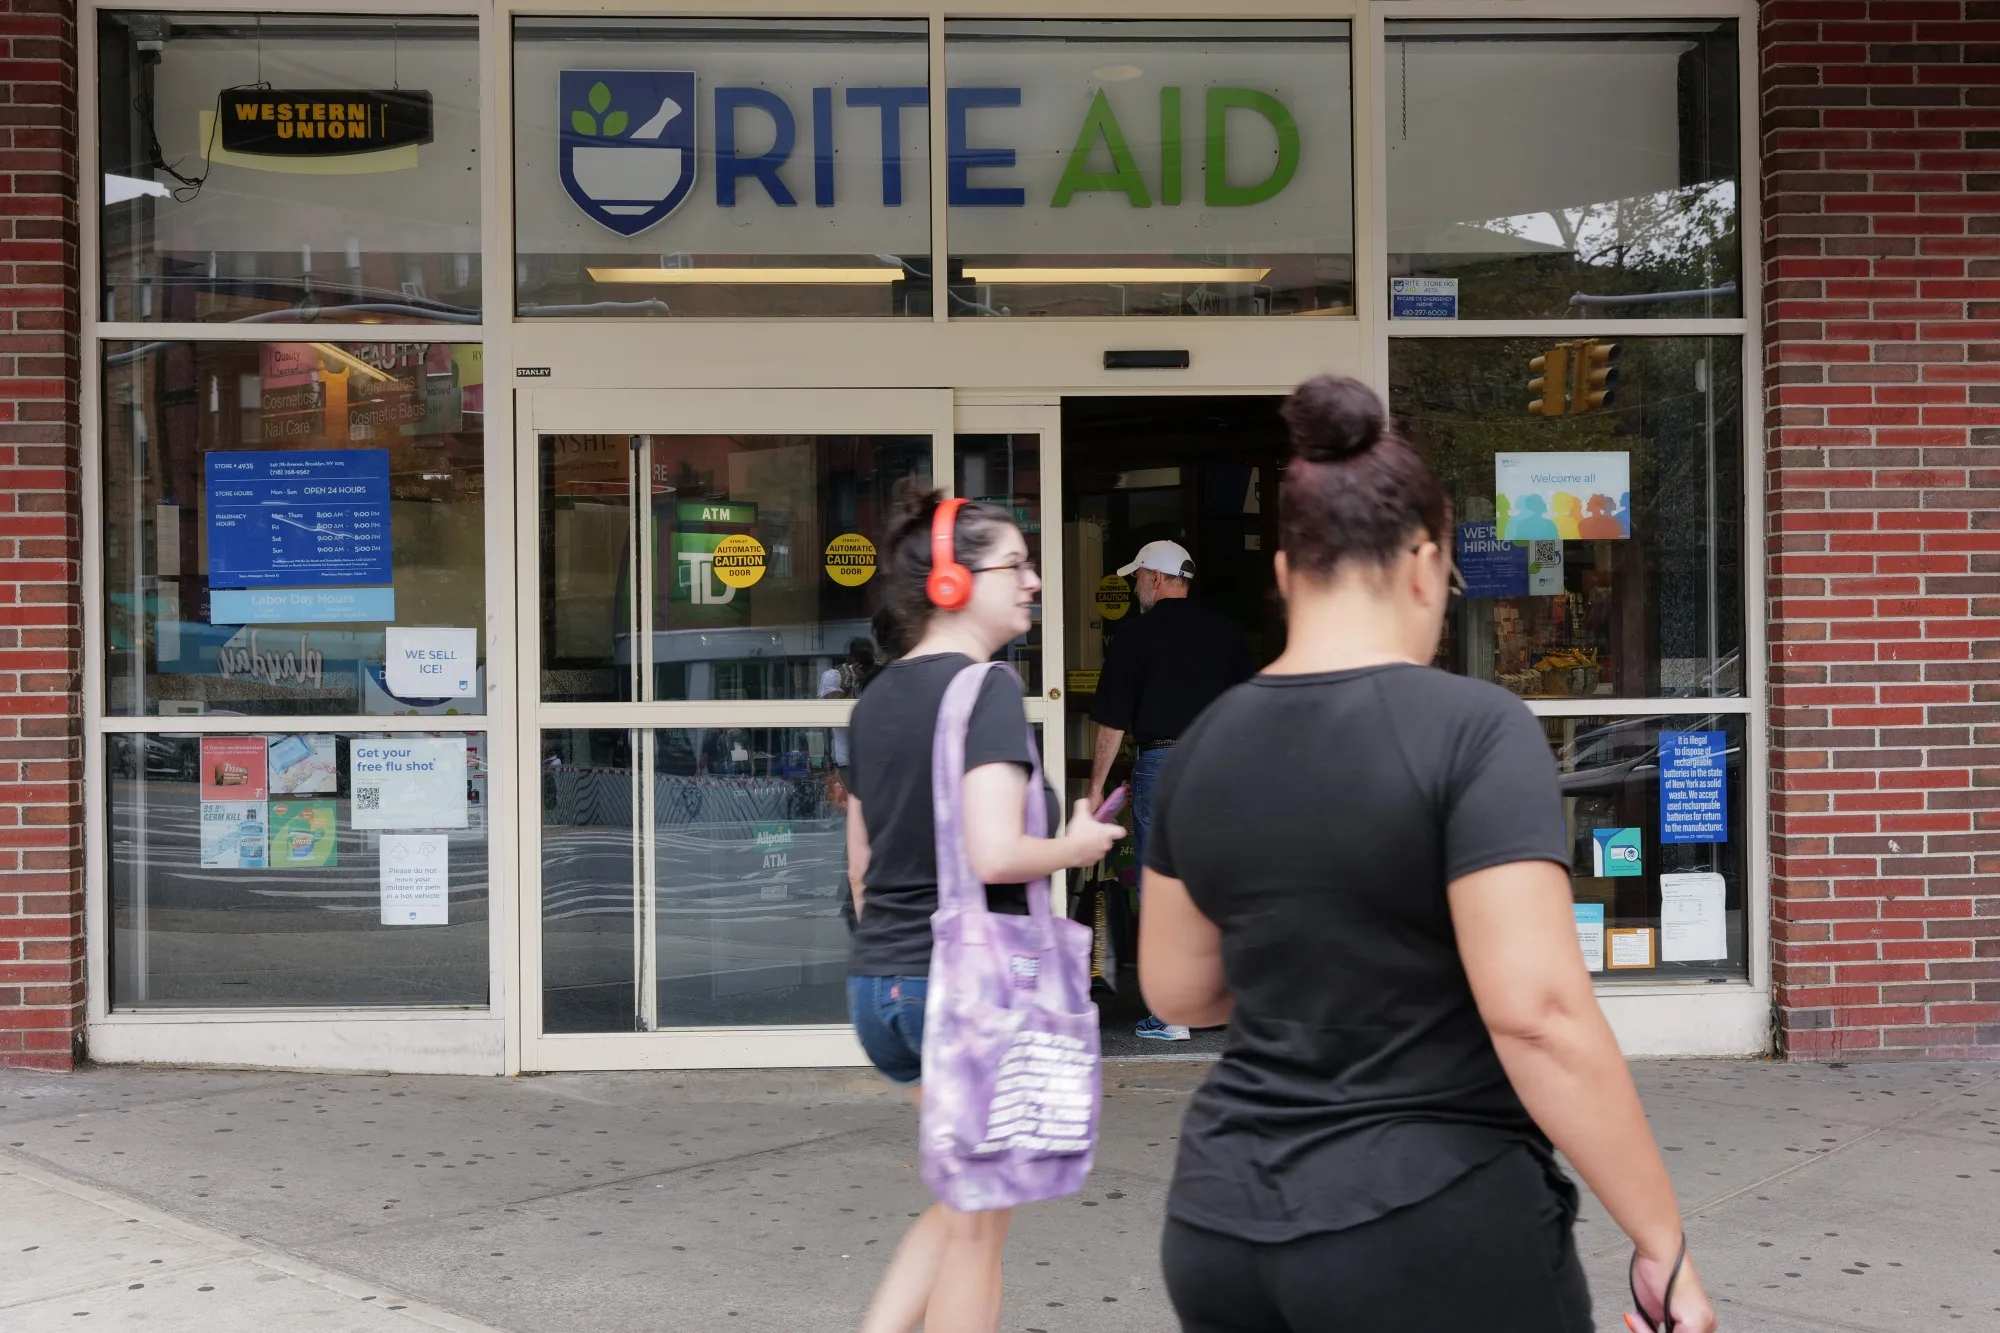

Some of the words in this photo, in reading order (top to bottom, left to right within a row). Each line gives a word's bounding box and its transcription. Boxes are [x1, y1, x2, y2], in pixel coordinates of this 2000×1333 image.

[235, 104, 365, 121] WESTERN
[277, 122, 365, 138] UNION
[714, 87, 1025, 208] RITE
[1050, 87, 1300, 208] AID
[275, 350, 300, 362] Quality
[358, 375, 415, 397] Cosmetics
[263, 390, 315, 410] Cosmetics
[350, 405, 397, 426] Cosmetic
[399, 403, 425, 420] Bags
[265, 421, 283, 439] Nail
[286, 420, 310, 435] Care
[1531, 474, 1581, 483] Welcome
[1583, 474, 1596, 483] all
[338, 486, 366, 494] HOURS
[702, 507, 730, 521] ATM
[1463, 526, 1497, 539] WE'R
[717, 545, 761, 553] AUTOMATIC
[1464, 540, 1511, 553] HIRING
[715, 556, 763, 566] CAUTION
[827, 555, 874, 565] CAUTION
[252, 594, 287, 605] Labor
[291, 594, 315, 606] Day
[318, 593, 354, 604] Hours
[1098, 593, 1129, 602] CAUTION
[405, 650, 425, 660] WE
[428, 650, 458, 660] SELL
[420, 664, 443, 674] ICE!
[1678, 736, 1683, 745] It
[1683, 736, 1688, 744] is
[1689, 735, 1707, 746] illegal
[357, 748, 379, 758] Get
[383, 749, 411, 760] your
[1674, 747, 1681, 756] to
[1682, 747, 1704, 758] dispose
[1704, 746, 1711, 756] of
[357, 762, 382, 772] free
[386, 762, 402, 771] flu
[1674, 757, 1712, 768] rechargeable
[1664, 769, 1689, 778] batteries
[1690, 768, 1696, 778] in
[1697, 768, 1707, 777] the
[1707, 768, 1723, 777] state
[1665, 779, 1672, 789] of
[1672, 779, 1685, 788] New
[1686, 779, 1698, 788] York
[1707, 778, 1721, 788] solid
[1669, 791, 1688, 799] waste.
[1689, 790, 1698, 799] We
[1699, 790, 1718, 801] accept
[204, 804, 226, 813] 99.9%
[1667, 801, 1681, 811] used
[1682, 800, 1720, 812] rechargeable
[204, 813, 225, 821] GERM
[226, 813, 241, 821] KILL
[1667, 812, 1692, 822] batteries
[1693, 812, 1702, 821] for
[1702, 812, 1721, 820] return
[1665, 823, 1671, 832] to
[1672, 823, 1681, 832] the
[1682, 822, 1723, 832] manufacturer.
[756, 829, 792, 847] Allpoint
[763, 853, 787, 869] ATM
